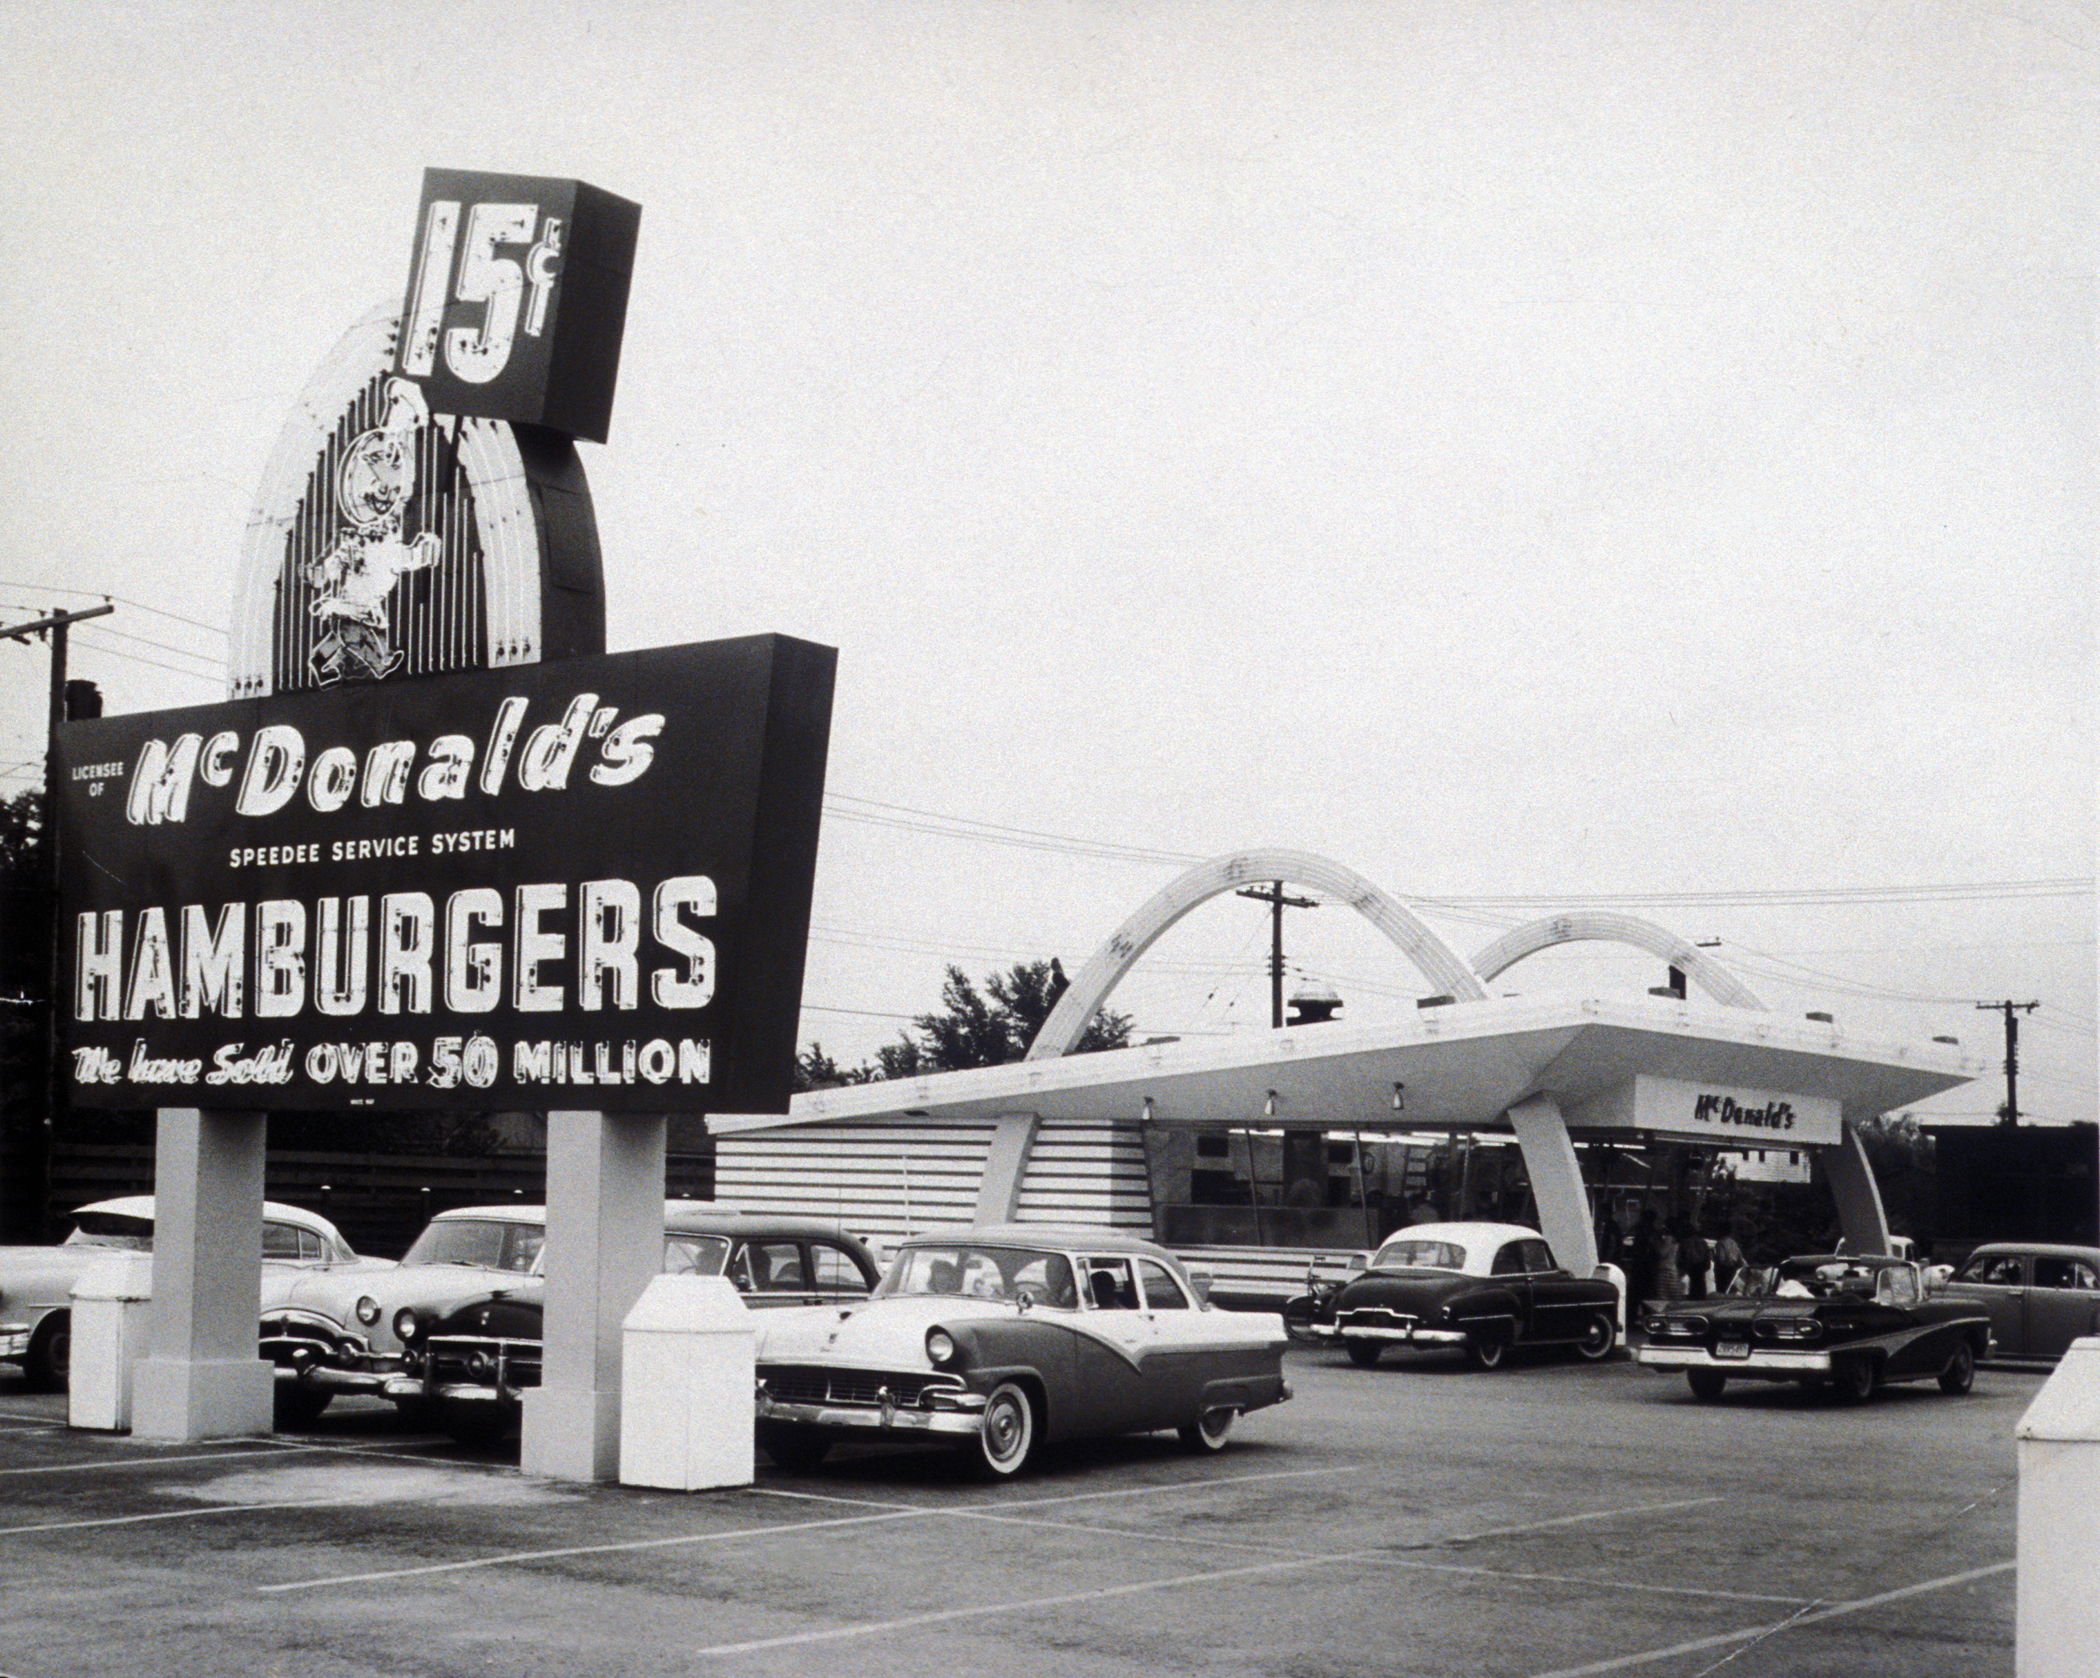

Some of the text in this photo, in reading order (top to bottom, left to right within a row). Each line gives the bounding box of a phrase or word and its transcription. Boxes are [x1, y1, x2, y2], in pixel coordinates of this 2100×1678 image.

[72, 762, 124, 781] LICENSEE
[126, 693, 666, 826] McDonald's
[88, 782, 105, 797] OF
[229, 828, 515, 868] SPEEDEE SERVICE SYSTEM
[75, 875, 718, 1022] HAMBURGERS
[71, 1031, 711, 1089] We have Sold OVER 50 MILLION
[1694, 1093, 1796, 1130] McDonald's
